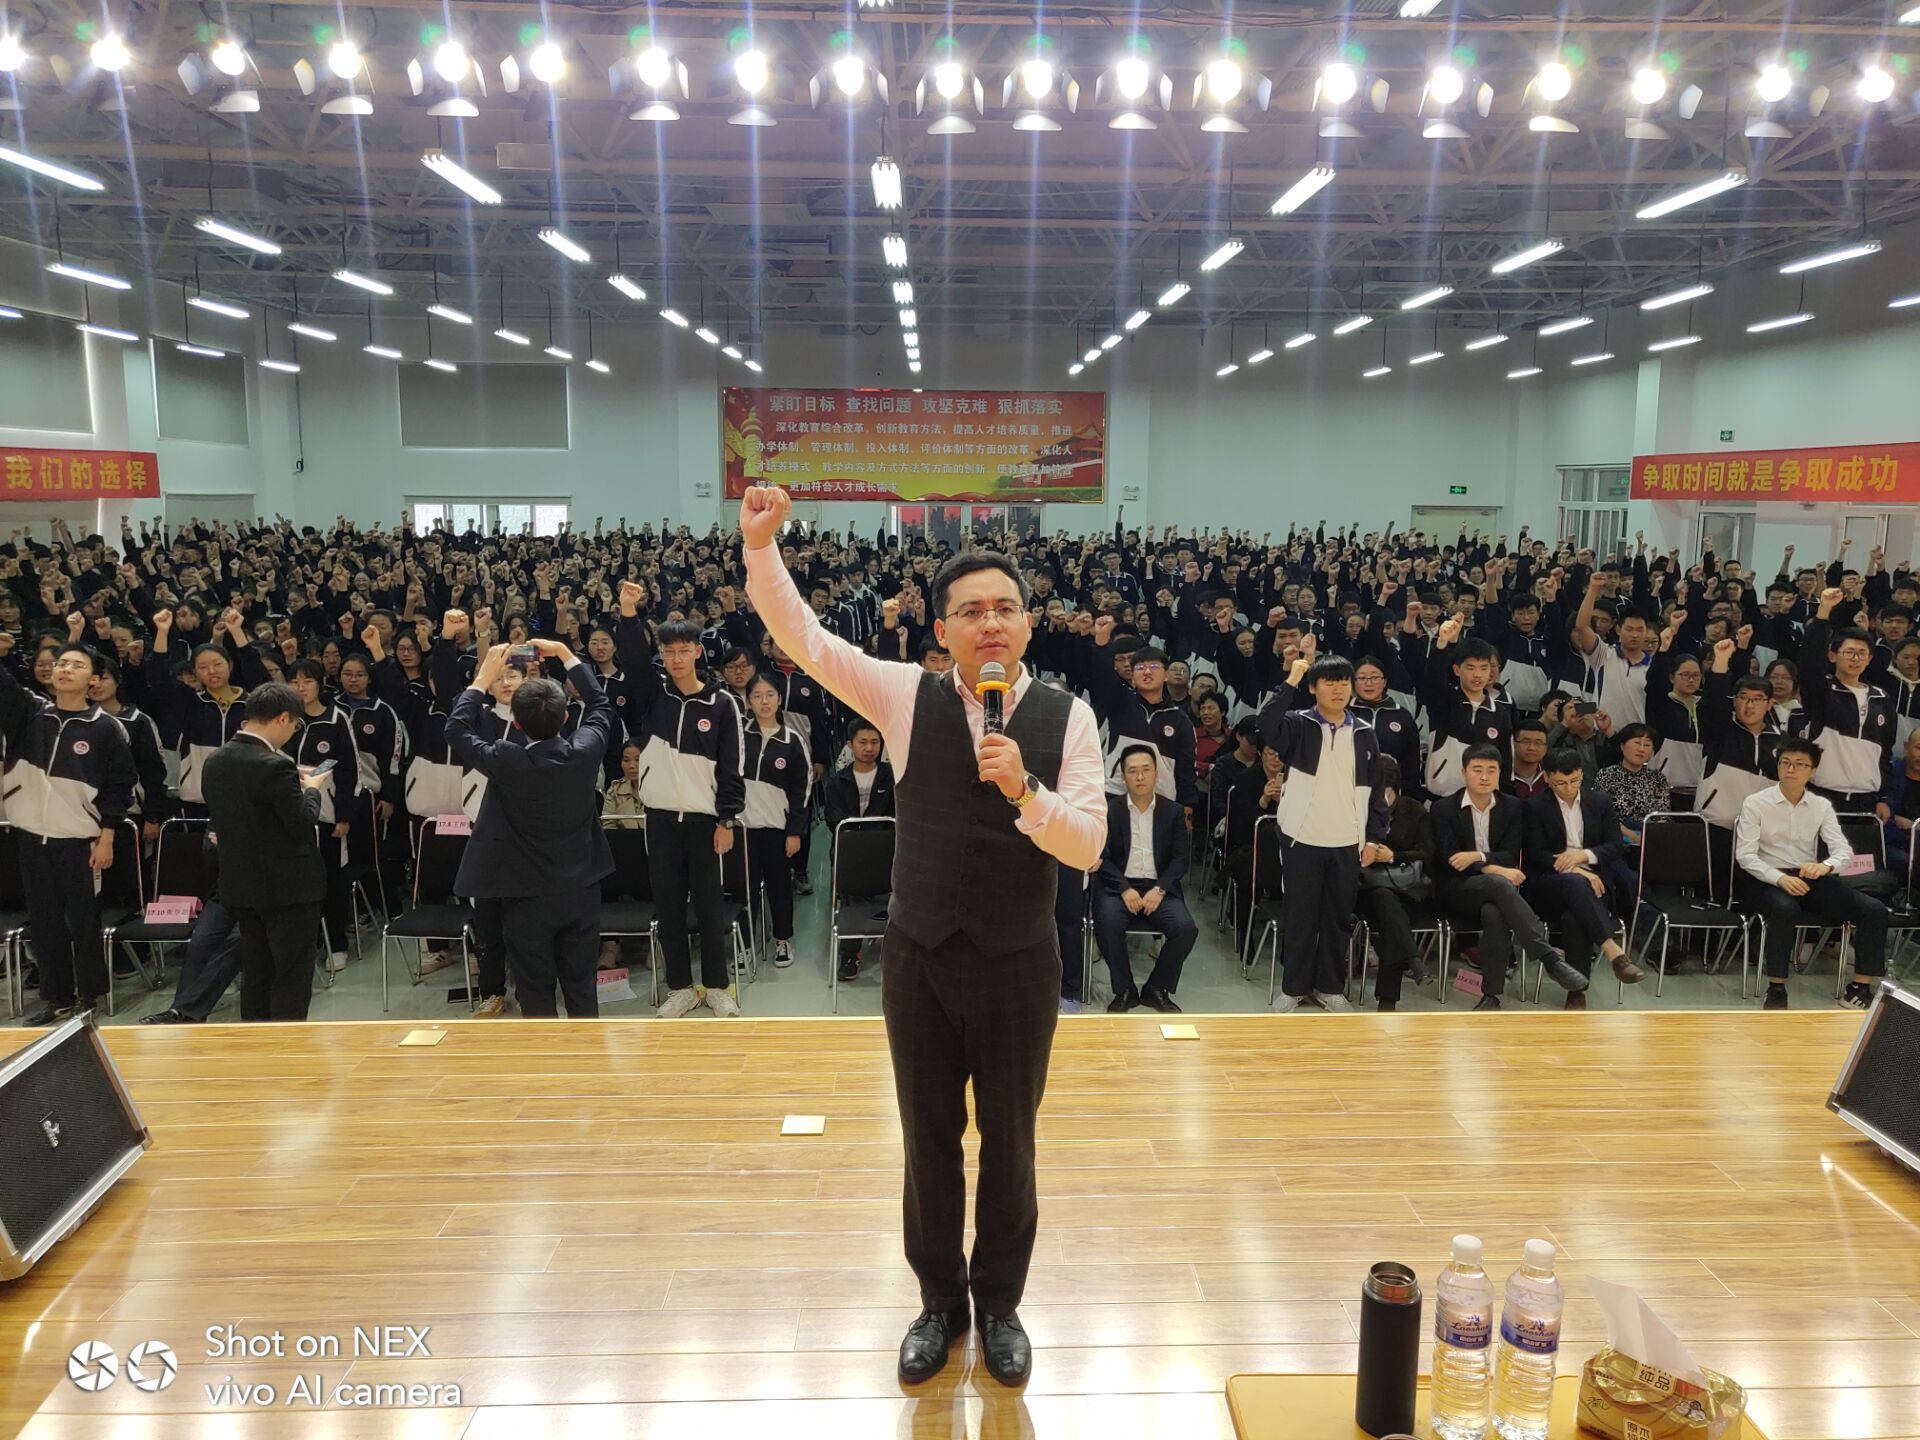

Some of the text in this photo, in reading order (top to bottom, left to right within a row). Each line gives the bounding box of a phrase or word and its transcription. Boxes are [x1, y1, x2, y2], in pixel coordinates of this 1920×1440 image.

[769, 395, 1063, 415] 紧盯目标 查找问题 攻坚克难 狠抓落实
[5, 455, 147, 490] 我们的选择
[1643, 454, 1899, 492] 争取时间就是争取成功
[1638, 1369, 1671, 1391] 纯品
[1626, 1421, 1650, 1439] 原木
